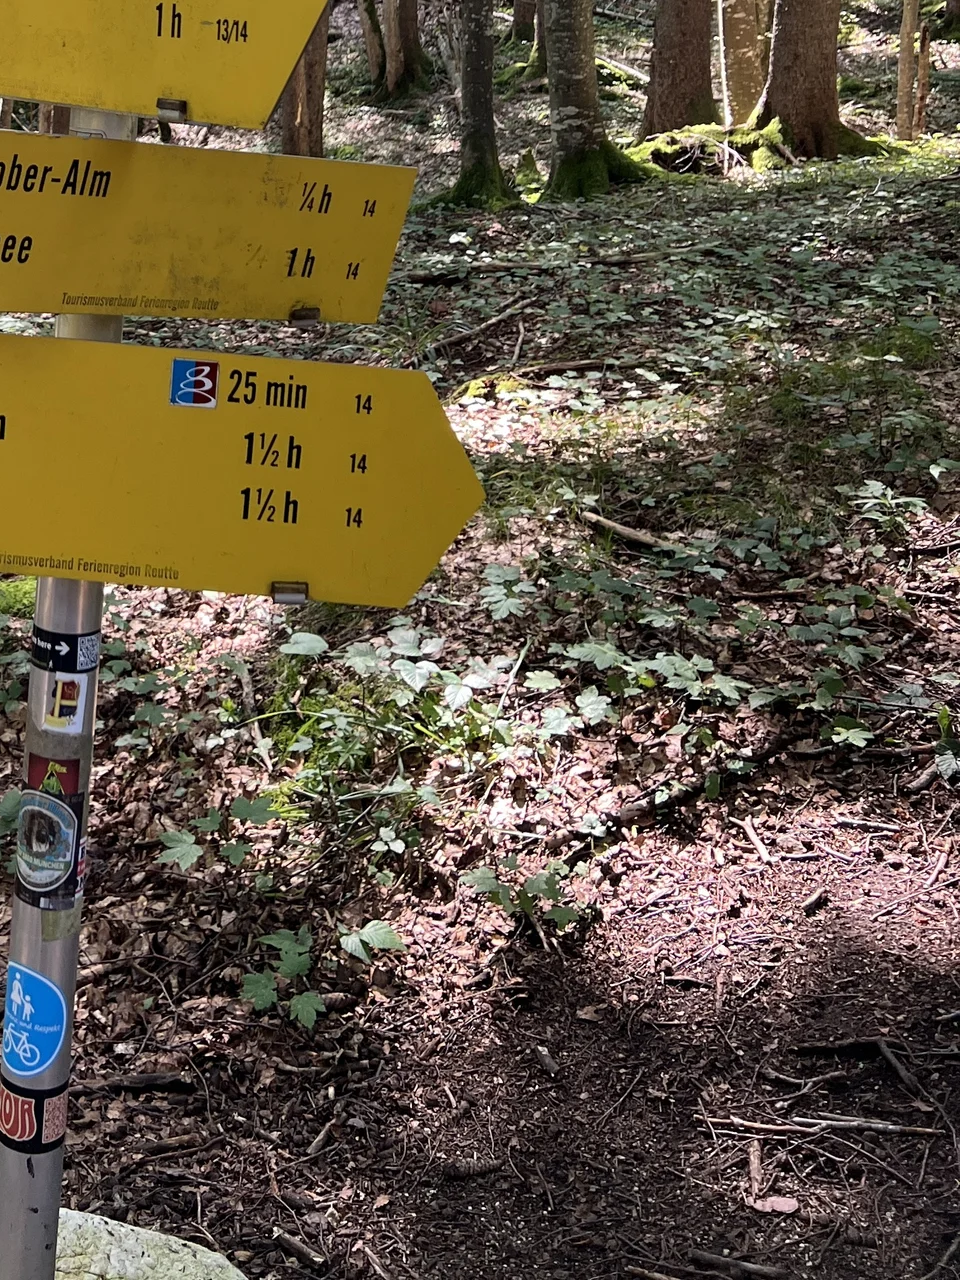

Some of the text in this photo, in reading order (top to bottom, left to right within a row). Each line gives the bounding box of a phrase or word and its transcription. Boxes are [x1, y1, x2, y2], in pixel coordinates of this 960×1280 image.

[155, 2, 163, 37] 1
[171, 3, 182, 39] h
[216, 18, 248, 43] 13/14
[299, 181, 317, 212] ¼
[318, 184, 332, 214] h
[362, 199, 376, 217] 14
[287, 247, 298, 277] 1
[301, 248, 315, 278] h
[346, 262, 360, 280] 14
[62, 292, 219, 312] Tourismusverband Ferienregion Reutte
[227, 370, 259, 406] 25
[266, 373, 308, 410] min
[354, 394, 373, 415] 14
[243, 432, 280, 469] 1½
[285, 436, 302, 470] h
[350, 453, 368, 474] 14
[240, 487, 277, 523] 1½
[281, 491, 299, 524] h
[345, 507, 364, 529] 14
[77, 558, 141, 578] Ferienregion
[144, 563, 179, 580] Reutte
